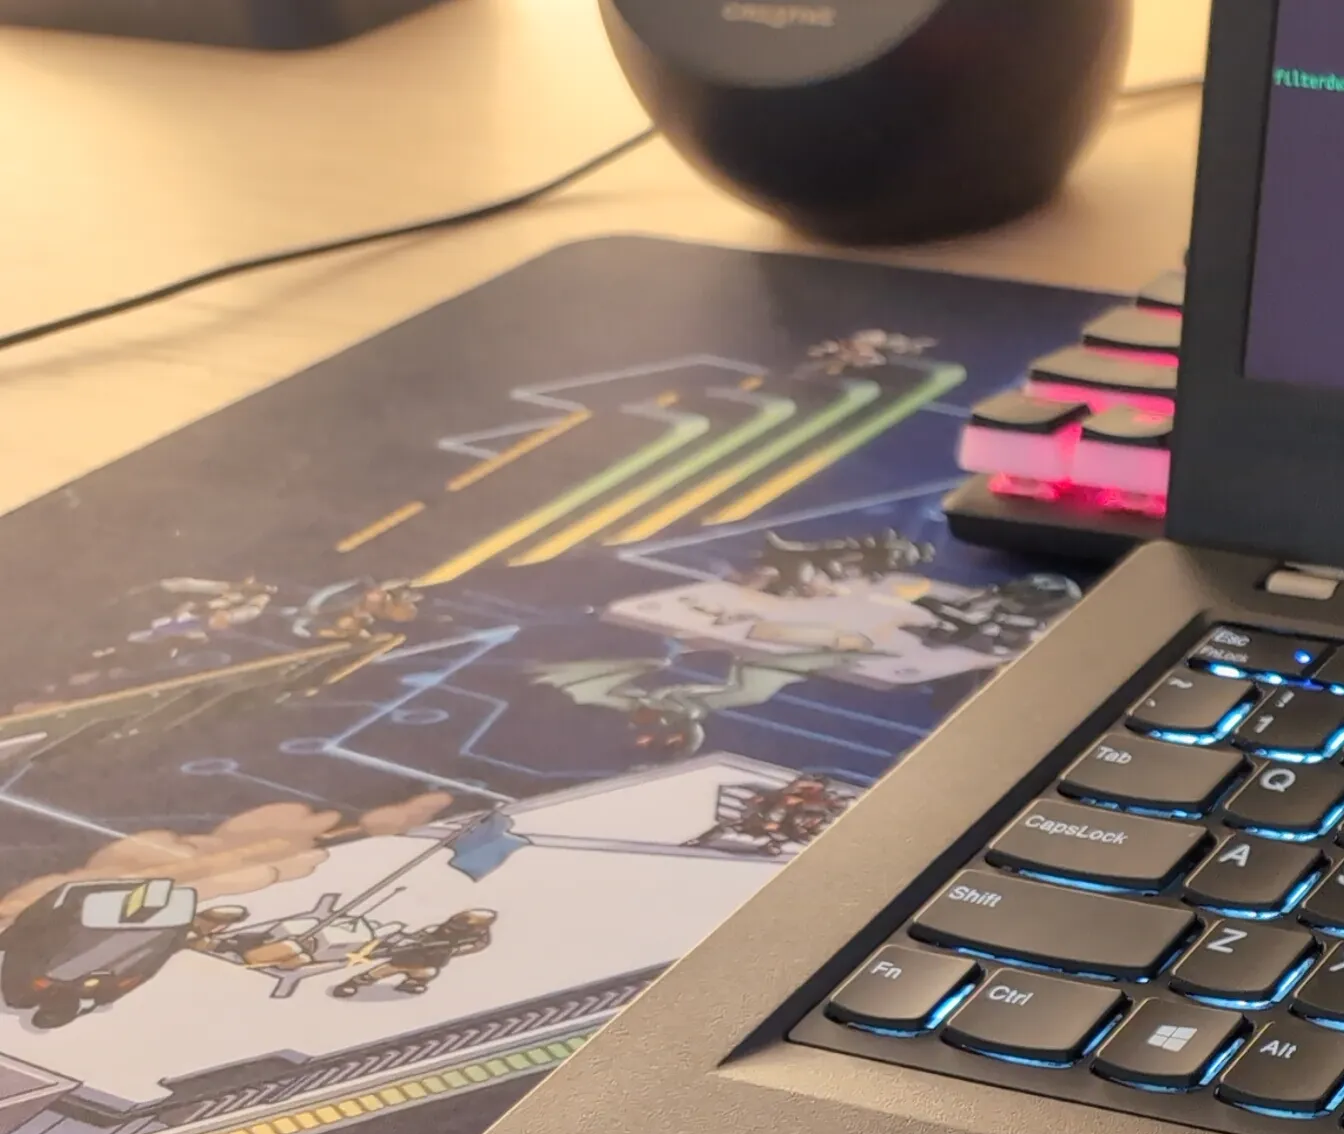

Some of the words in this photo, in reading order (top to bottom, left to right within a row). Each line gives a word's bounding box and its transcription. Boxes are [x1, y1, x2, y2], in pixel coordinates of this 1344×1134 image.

[1254, 715, 1273, 733] 1
[1097, 746, 1132, 764] Tab
[1260, 769, 1295, 792] Q
[1024, 815, 1129, 846] CapsLock
[1218, 844, 1251, 867] A
[948, 885, 1002, 908] Shift
[1206, 928, 1249, 954] Z
[870, 960, 902, 980] Fn
[988, 984, 1033, 1007] Ctrl
[1259, 1039, 1297, 1059] Alt
